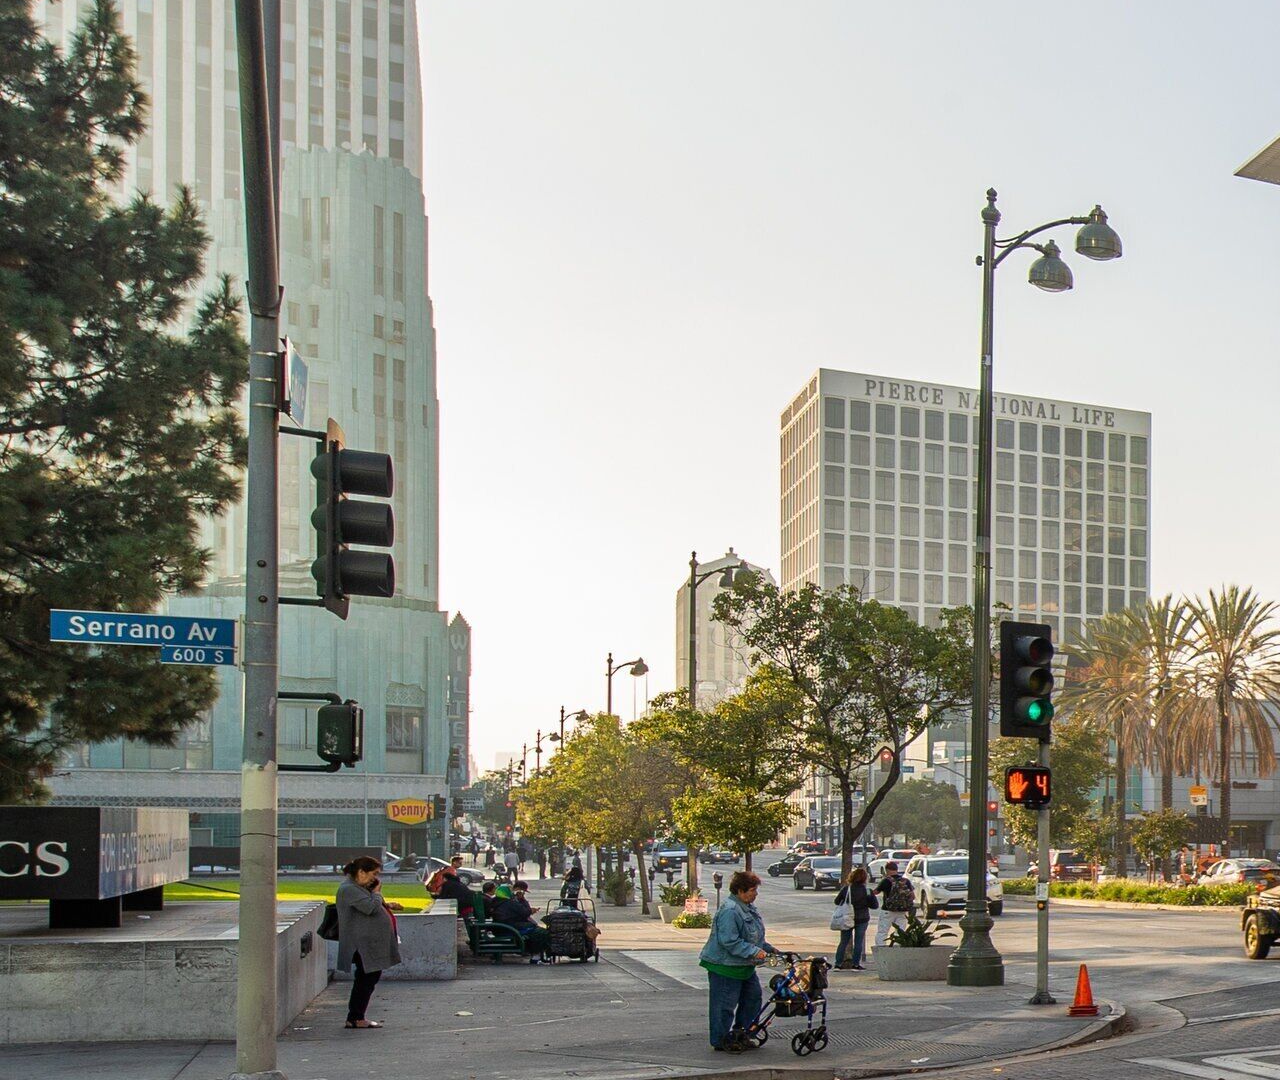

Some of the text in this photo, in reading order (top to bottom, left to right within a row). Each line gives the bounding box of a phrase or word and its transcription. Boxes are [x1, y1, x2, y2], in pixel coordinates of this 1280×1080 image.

[864, 379, 944, 404] PIERCE
[1073, 407, 1115, 428] LIFE
[68, 615, 218, 641] Serrano Av
[173, 648, 224, 663] 600 S
[1036, 775, 1047, 796] 4
